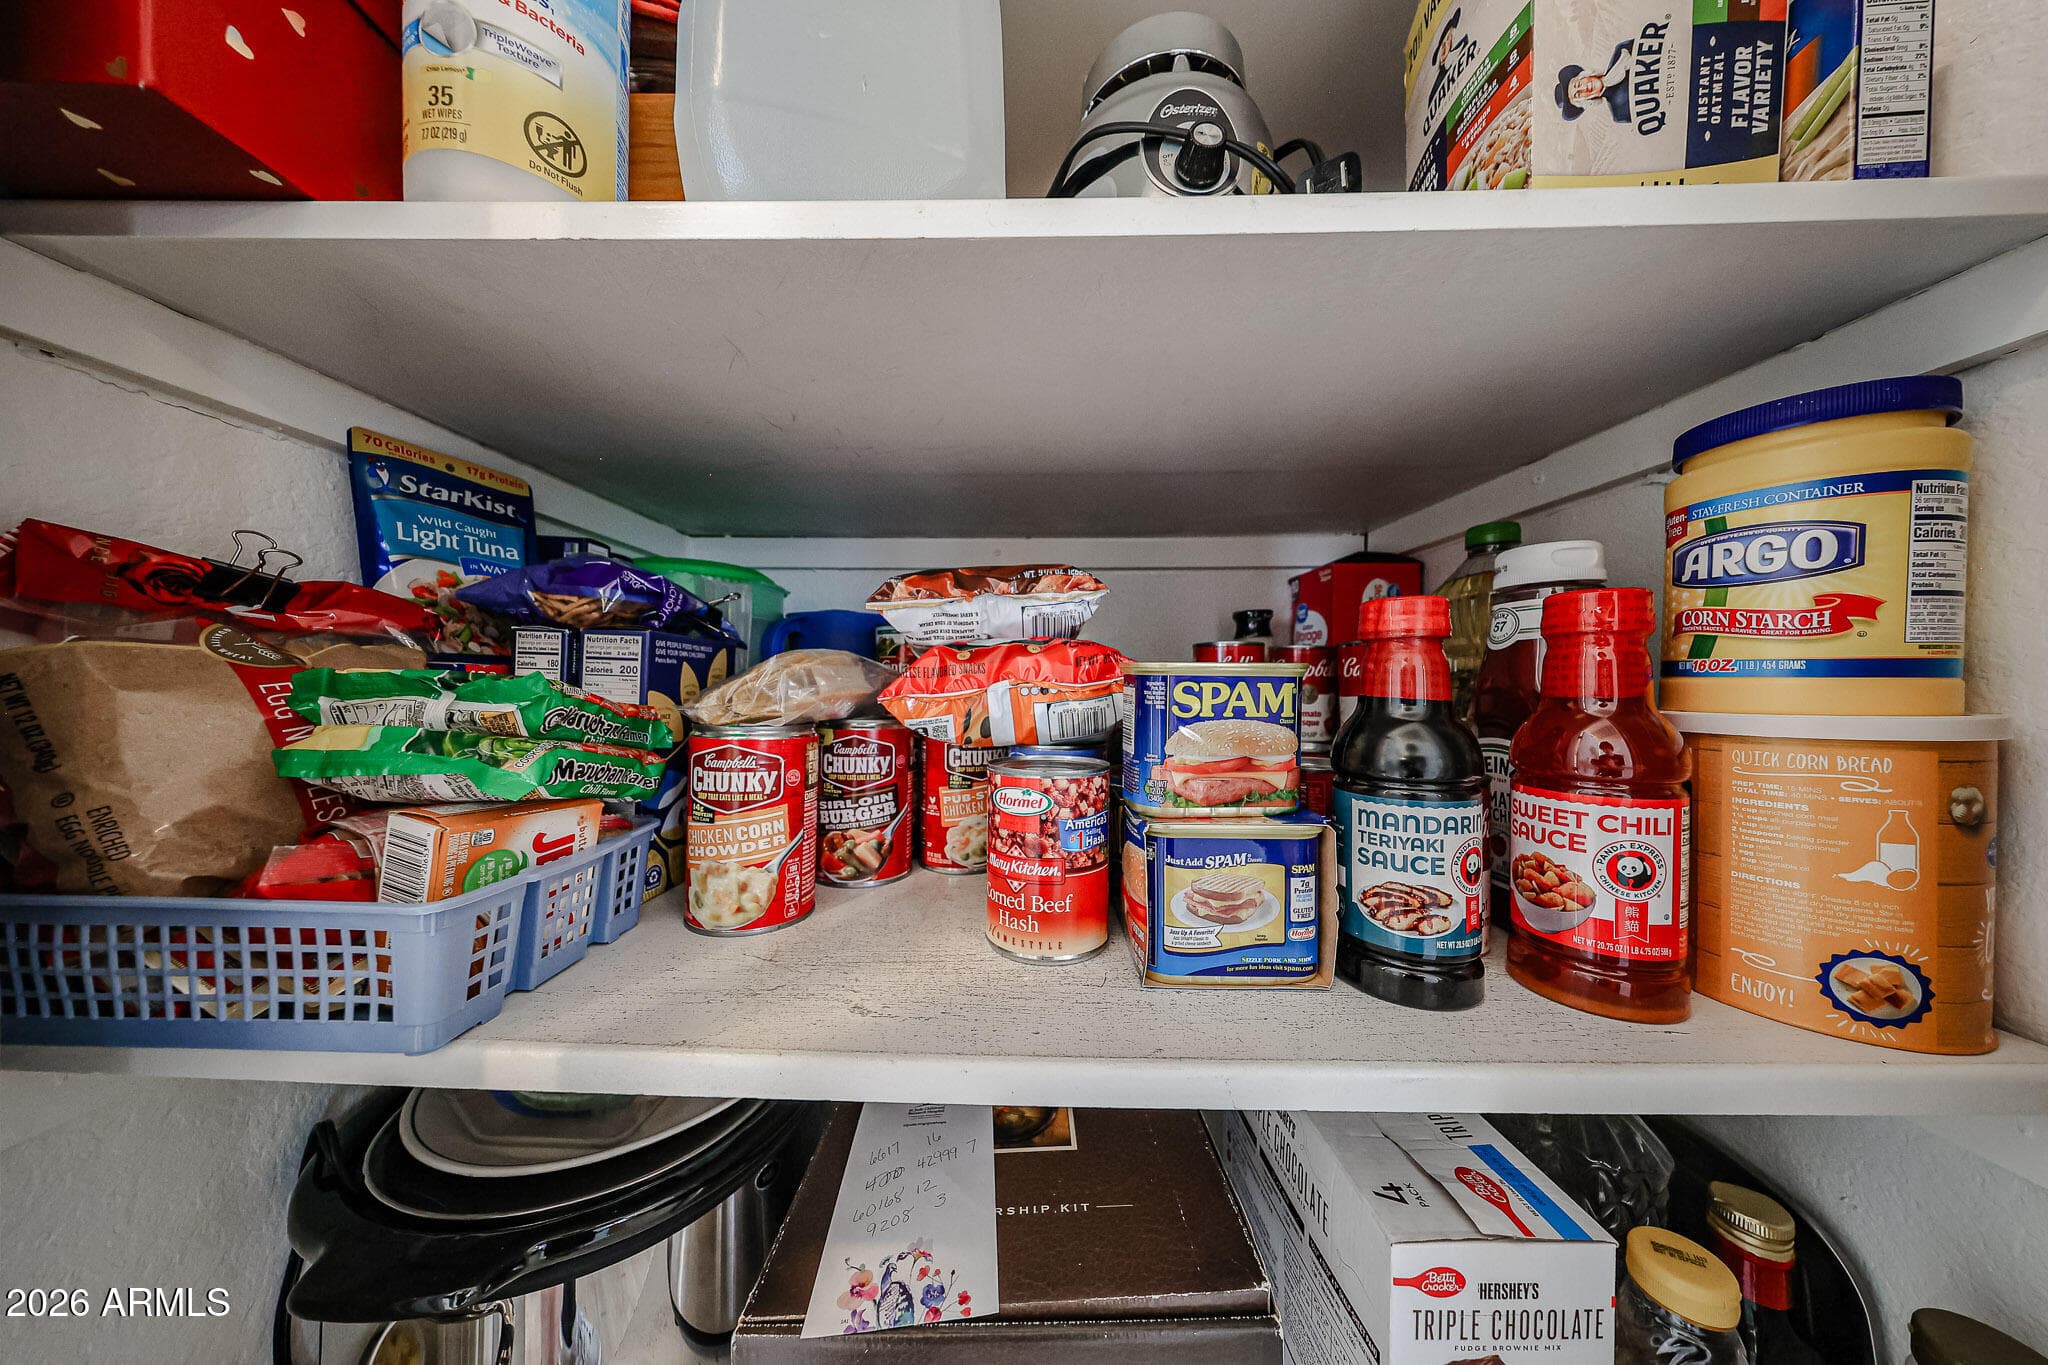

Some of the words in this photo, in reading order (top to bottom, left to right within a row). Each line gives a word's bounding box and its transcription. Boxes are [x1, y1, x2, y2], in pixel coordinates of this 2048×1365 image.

[515, 0, 586, 56] Bacteria
[496, 42, 540, 69] Texture
[1423, 40, 1478, 136] QUAKER
[1634, 22, 1670, 136] QUAKER
[1697, 56, 1711, 123] INSTANT
[1711, 52, 1725, 125] OATMEAL
[1731, 46, 1752, 128] FLAVOR
[1752, 40, 1774, 135] VARIETY
[428, 85, 454, 106] 35
[422, 109, 437, 119] WET
[438, 108, 463, 120] WIPES
[1160, 104, 1218, 119] Osterizer
[529, 159, 543, 172] Do
[543, 166, 560, 182] Not
[561, 174, 583, 196] Flush
[362, 433, 383, 448] 70
[385, 440, 436, 464] Calories
[466, 465, 486, 481] 17g
[488, 472, 525, 490] Protein
[399, 474, 517, 519] StarKist
[1915, 483, 1955, 494] Nutrition
[1692, 497, 1760, 520] STAY-FRESH
[1764, 482, 1865, 505] CONTAINER
[417, 514, 452, 530] Wild
[456, 522, 497, 539] Caught
[1913, 527, 1956, 539] Calories
[396, 521, 460, 551] Light
[463, 535, 520, 561] Tuna
[1682, 529, 1839, 583] ARGO
[479, 562, 509, 575] WAT
[1493, 621, 1507, 632] 57
[1682, 610, 1730, 627] CORN
[1735, 609, 1832, 629] STARCH
[518, 632, 542, 641] Nutrition
[543, 633, 560, 641] Facts
[586, 635, 618, 645] Nutrition
[620, 636, 640, 645] Facts
[666, 641, 682, 650] PEOPLE
[547, 659, 559, 668] 180
[666, 649, 678, 657] YOUR
[584, 666, 614, 674] Calories
[619, 665, 638, 675] 200
[959, 663, 986, 675] SNACKS
[1762, 661, 1776, 670] 454
[1779, 661, 1806, 670] GRAMS
[258, 681, 293, 720] EGG
[1171, 681, 1295, 718] SPAM
[833, 743, 879, 756] Campbell's
[550, 757, 624, 785] Maruchan
[704, 753, 758, 771] Campbell's
[823, 753, 891, 775] CHUNKY
[1731, 749, 1781, 767] QUICK
[1786, 753, 1829, 769] CORN
[1837, 756, 1893, 773] BREAD
[580, 784, 602, 795] Chili
[694, 767, 778, 794] CHUNKY
[1757, 782, 1783, 791] TIME:
[820, 791, 894, 810] SIRLOIN
[998, 792, 1043, 810] Hormel
[1731, 796, 1809, 811] INGREDIENTS
[1732, 786, 1759, 795] TOTAL
[1762, 790, 1788, 798] TIME:
[1838, 797, 1881, 805] SERVES:
[820, 801, 897, 823] BURGER
[943, 801, 984, 817] CHICKEN
[1512, 799, 1589, 829] SWEET
[1597, 814, 1672, 836] CHILI
[86, 805, 132, 862] ENRICHED
[689, 828, 733, 844] CHICKEN
[736, 819, 785, 840] CORN
[1065, 815, 1107, 831] America's
[1739, 828, 1784, 840] teaspoons
[689, 834, 786, 857] CHOWDER
[1085, 835, 1105, 848] Hash
[1358, 829, 1444, 853] TERIYAKI
[1512, 821, 1587, 853] SAUCE
[1742, 835, 1782, 846] teaspoon
[55, 814, 85, 841] EGG
[70, 839, 112, 887] NOODLE
[1165, 857, 1184, 866] Just
[1185, 857, 1203, 866] Add
[1204, 853, 1247, 869] SPAM
[1358, 847, 1446, 875] SAUCE
[1454, 843, 1471, 866] PANDA
[1597, 843, 1626, 865] PANDA
[1630, 842, 1664, 870] EXPRESS
[988, 853, 1010, 875] Mary
[1010, 859, 1060, 877] Kitchen
[1291, 864, 1315, 874] SPAM
[1299, 880, 1310, 888] 7g
[1600, 875, 1631, 898] CHINESE
[1634, 879, 1662, 899] KITCHEN
[1731, 870, 1801, 889] DIRECTIONS
[987, 881, 1026, 911] Corned
[1031, 894, 1073, 913] Beef
[998, 908, 1040, 934] Hash
[1291, 928, 1315, 938] Hormel
[1573, 935, 1585, 945] NET
[1586, 939, 1596, 948] WT
[1597, 941, 1614, 951] 20.75
[1731, 973, 1794, 1008] ENJOY!
[1427, 1114, 1474, 1141] TRIP
[966, 1138, 977, 1153] 7
[917, 1180, 938, 1194] 12
[1274, 1123, 1330, 1238] CHOCOLATE
[934, 1193, 947, 1207] 3
[1372, 1182, 1410, 1206] 4
[1402, 1181, 1431, 1208] PACK
[995, 1204, 1050, 1217] RSHIP
[1060, 1202, 1091, 1213] KIT
[866, 1205, 915, 1237] 9208
[1421, 1280, 1461, 1292] Crocker
[1426, 1271, 1456, 1284] Betty
[1478, 1282, 1539, 1300] HERSHEY'S
[1413, 1309, 1481, 1340] TRIPLE
[1492, 1308, 1605, 1340] CHOCOLATE
